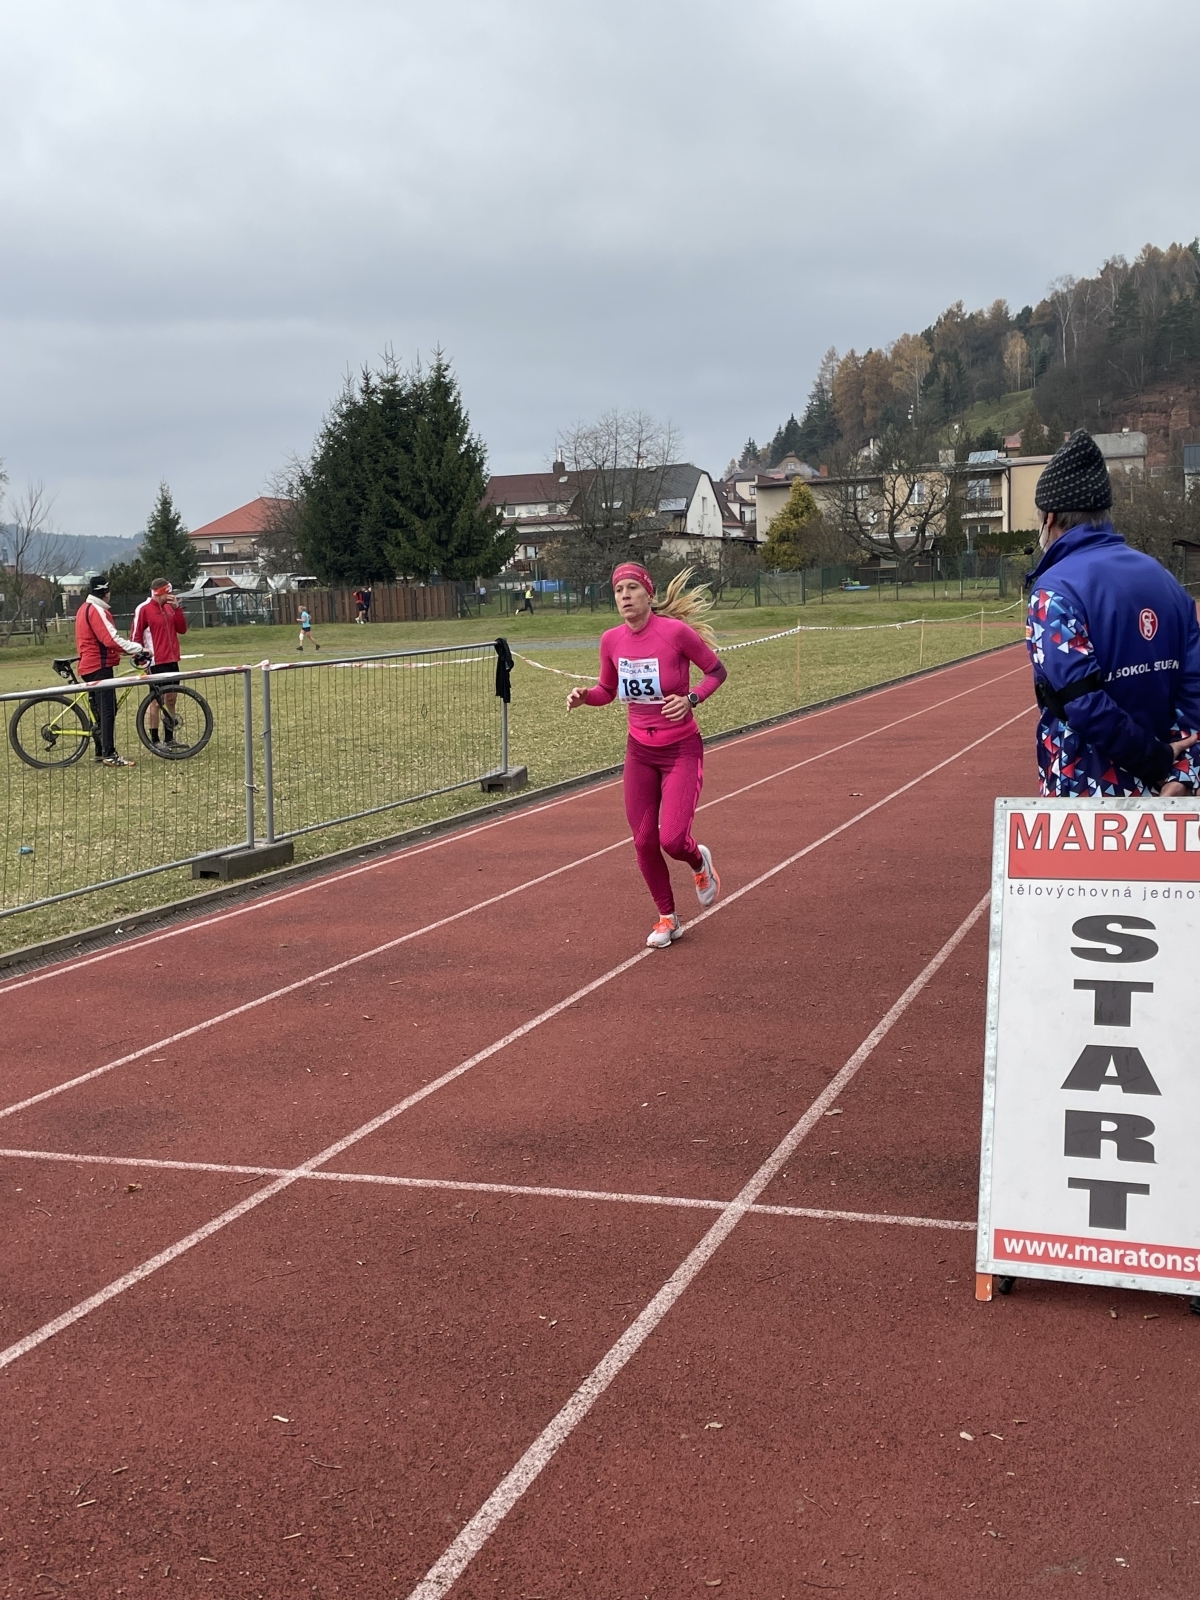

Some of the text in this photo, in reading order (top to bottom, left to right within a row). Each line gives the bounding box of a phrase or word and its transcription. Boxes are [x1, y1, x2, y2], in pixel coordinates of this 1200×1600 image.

[1115, 663, 1151, 678] SOKOL
[622, 678, 655, 696] 183
[1009, 812, 1200, 852] MARAT
[1009, 884, 1132, 899] tělovýchovná
[1060, 914, 1163, 1231] START
